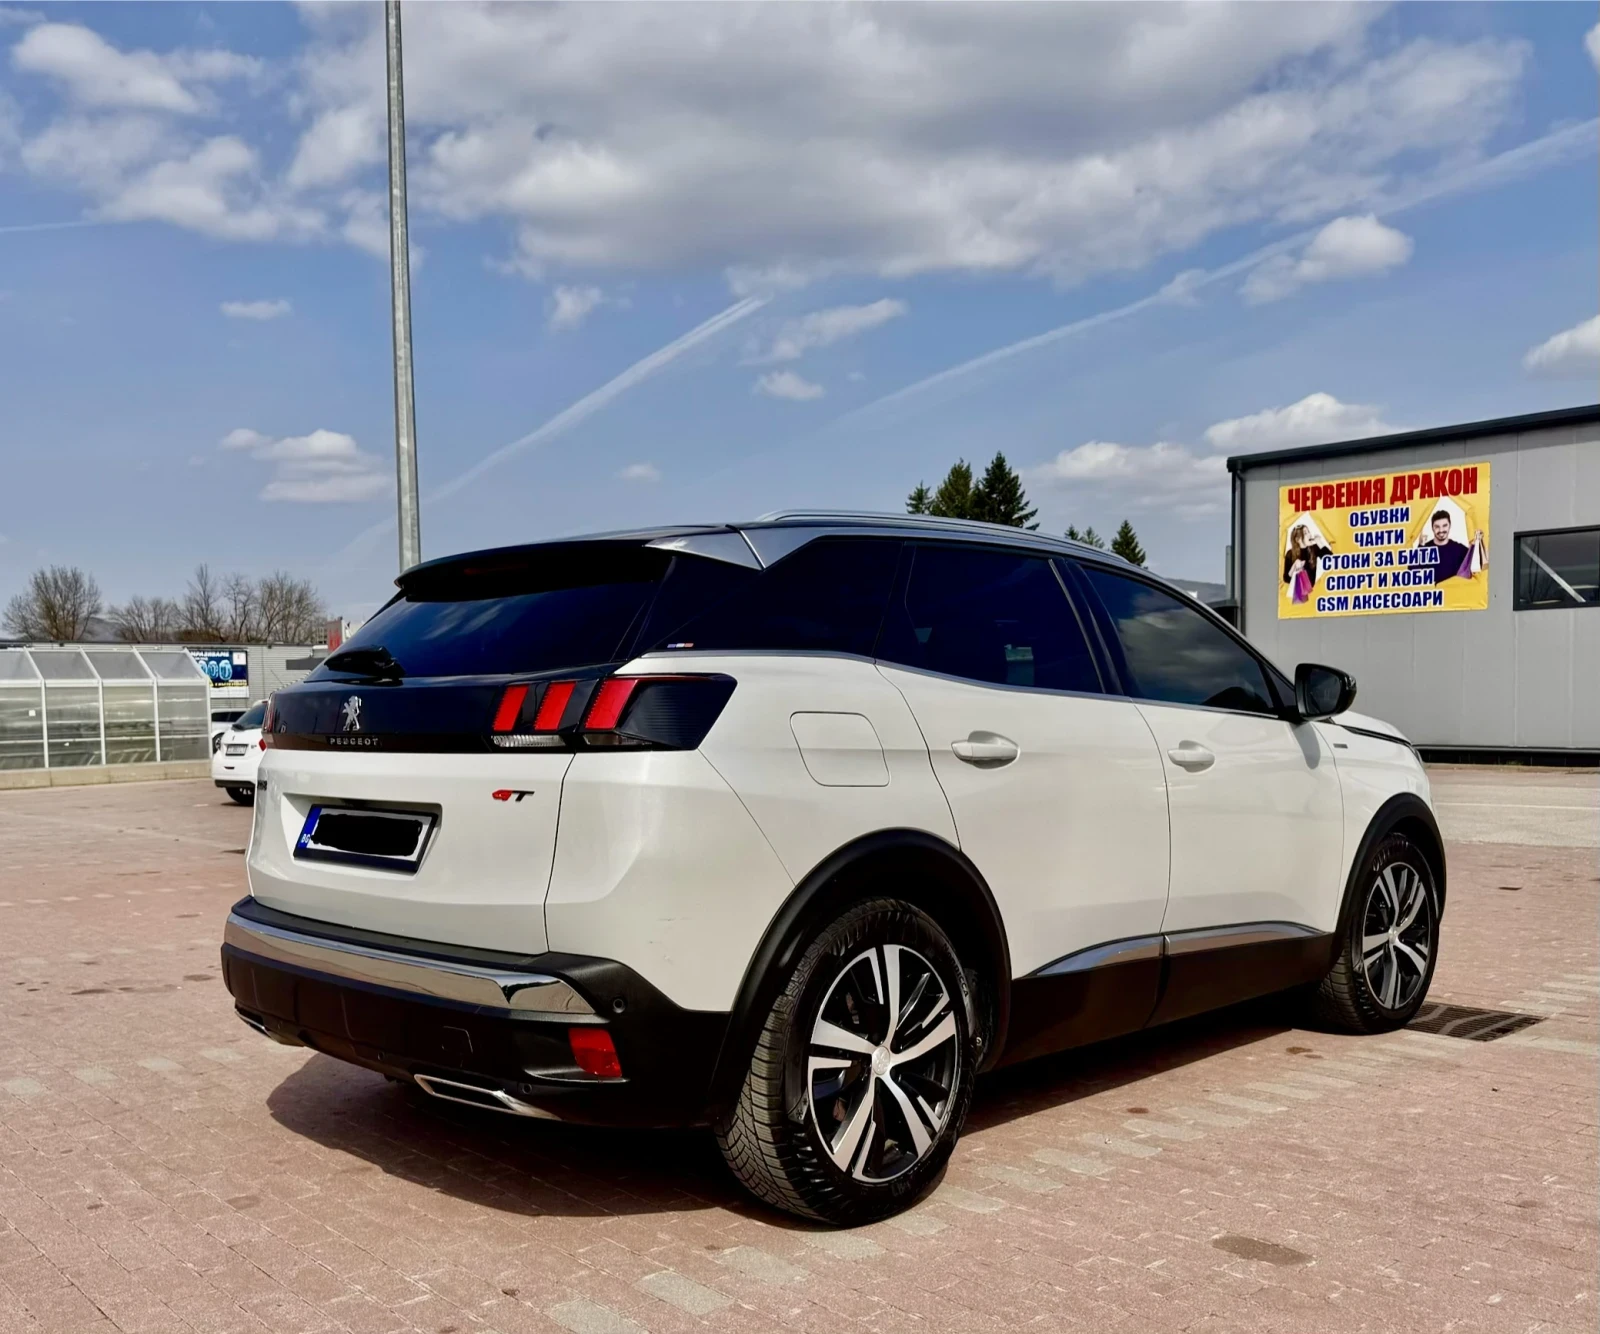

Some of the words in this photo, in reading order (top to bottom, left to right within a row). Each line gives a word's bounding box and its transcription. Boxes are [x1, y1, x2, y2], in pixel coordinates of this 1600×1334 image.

[1288, 477, 1385, 512] ЧЕРВЕНИЯ
[1390, 467, 1478, 505] ДРАКОН
[1350, 507, 1410, 527] ОБУВКИ
[1354, 529, 1404, 547] ЧАНТИ
[1322, 552, 1371, 571] СТОКИ
[1374, 550, 1394, 567] ЗА
[1398, 547, 1439, 566] БИТА
[1326, 573, 1375, 591] СПОРТ
[1378, 572, 1388, 588] И
[1391, 569, 1434, 587] ХОБИ
[1317, 596, 1349, 612] GSM
[1352, 591, 1443, 611] АКСЕСОАРИ
[329, 737, 379, 746] PEUGEOT
[492, 789, 535, 802] GT
[301, 833, 311, 844] BG
